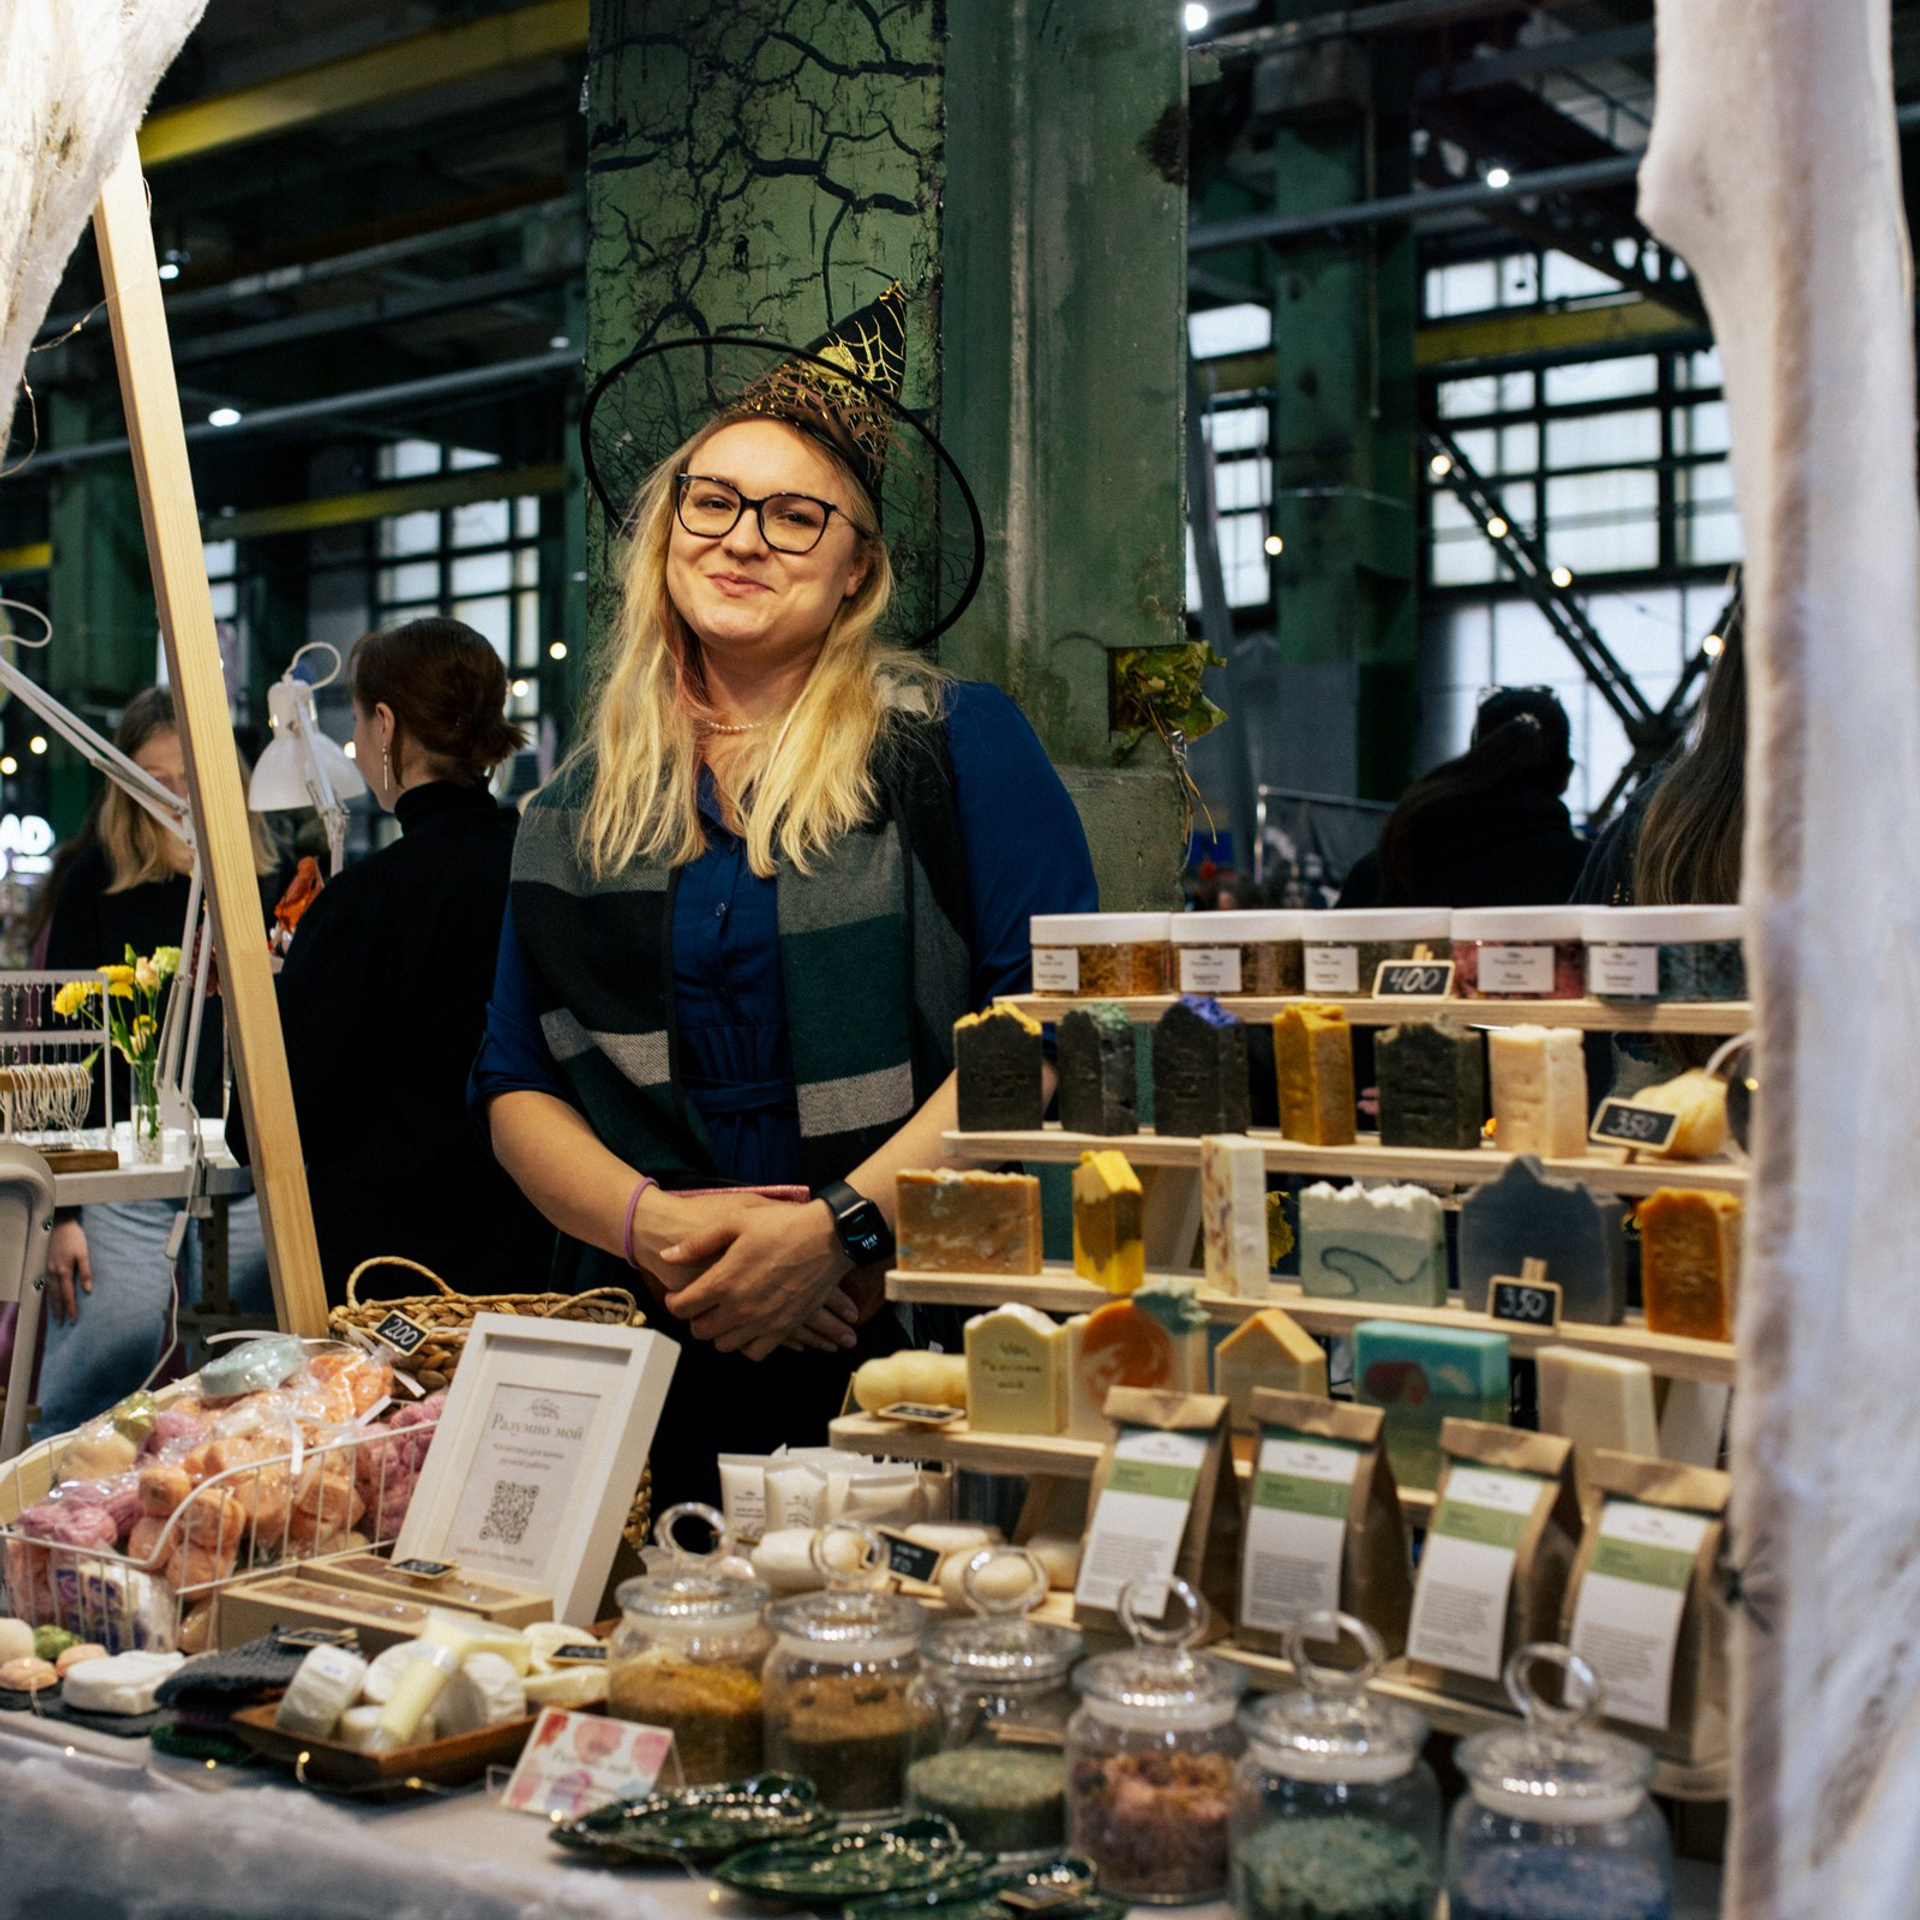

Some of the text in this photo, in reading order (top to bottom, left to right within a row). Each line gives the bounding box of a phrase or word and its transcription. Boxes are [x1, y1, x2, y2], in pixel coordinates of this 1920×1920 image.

[1390, 967, 1441, 993] 400
[1606, 1108, 1660, 1139] 350
[1499, 1286, 1548, 1318] 350
[382, 1318, 419, 1346] 200
[491, 1413, 584, 1441] Разумно мой
